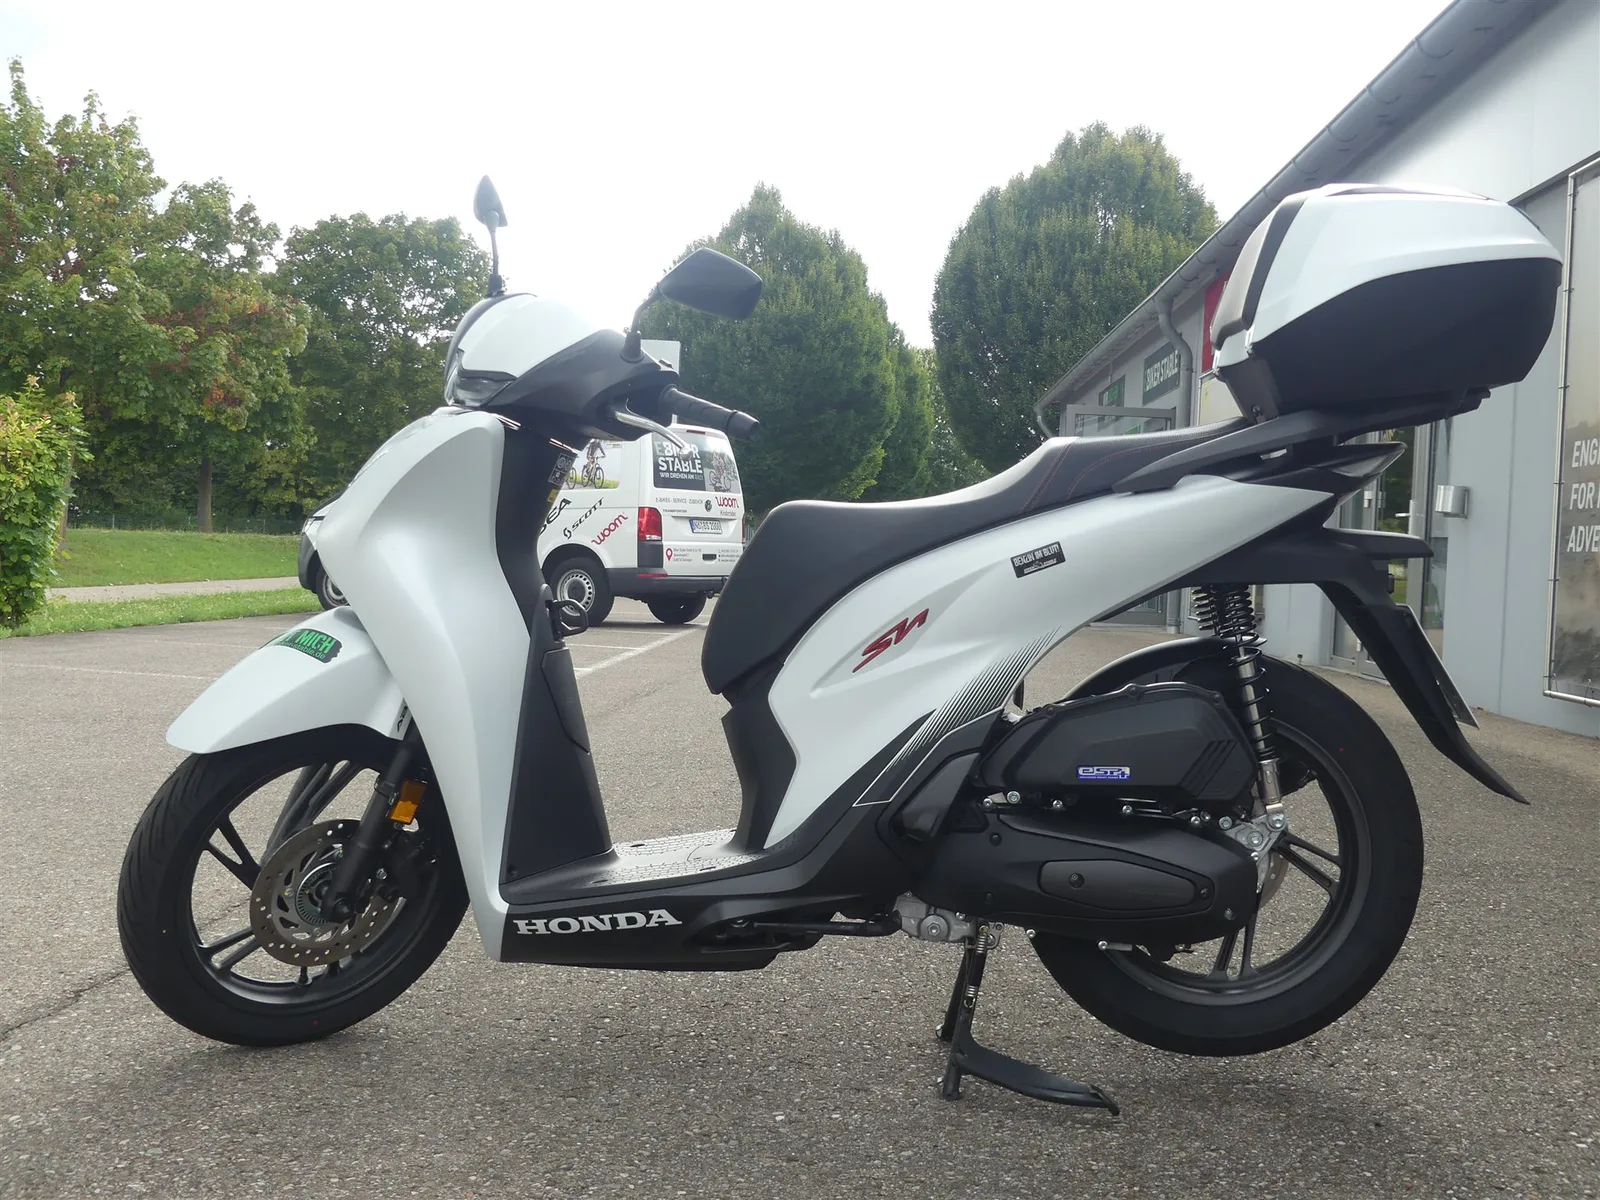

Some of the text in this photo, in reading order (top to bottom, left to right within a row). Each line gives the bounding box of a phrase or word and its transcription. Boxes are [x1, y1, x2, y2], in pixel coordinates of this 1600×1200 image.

[1160, 349, 1178, 383] STABLE
[654, 442, 700, 459] EBIR
[658, 457, 703, 473] STABLE
[715, 496, 739, 508] woom
[1569, 482, 1595, 510] FOR
[572, 497, 604, 532] SCOTT
[591, 514, 628, 545] woom
[1013, 552, 1035, 567] BENZIN
[1034, 550, 1044, 560] IM
[1042, 543, 1060, 557] BLUT!
[295, 630, 337, 654] MICH
[513, 908, 682, 935] HONDA
